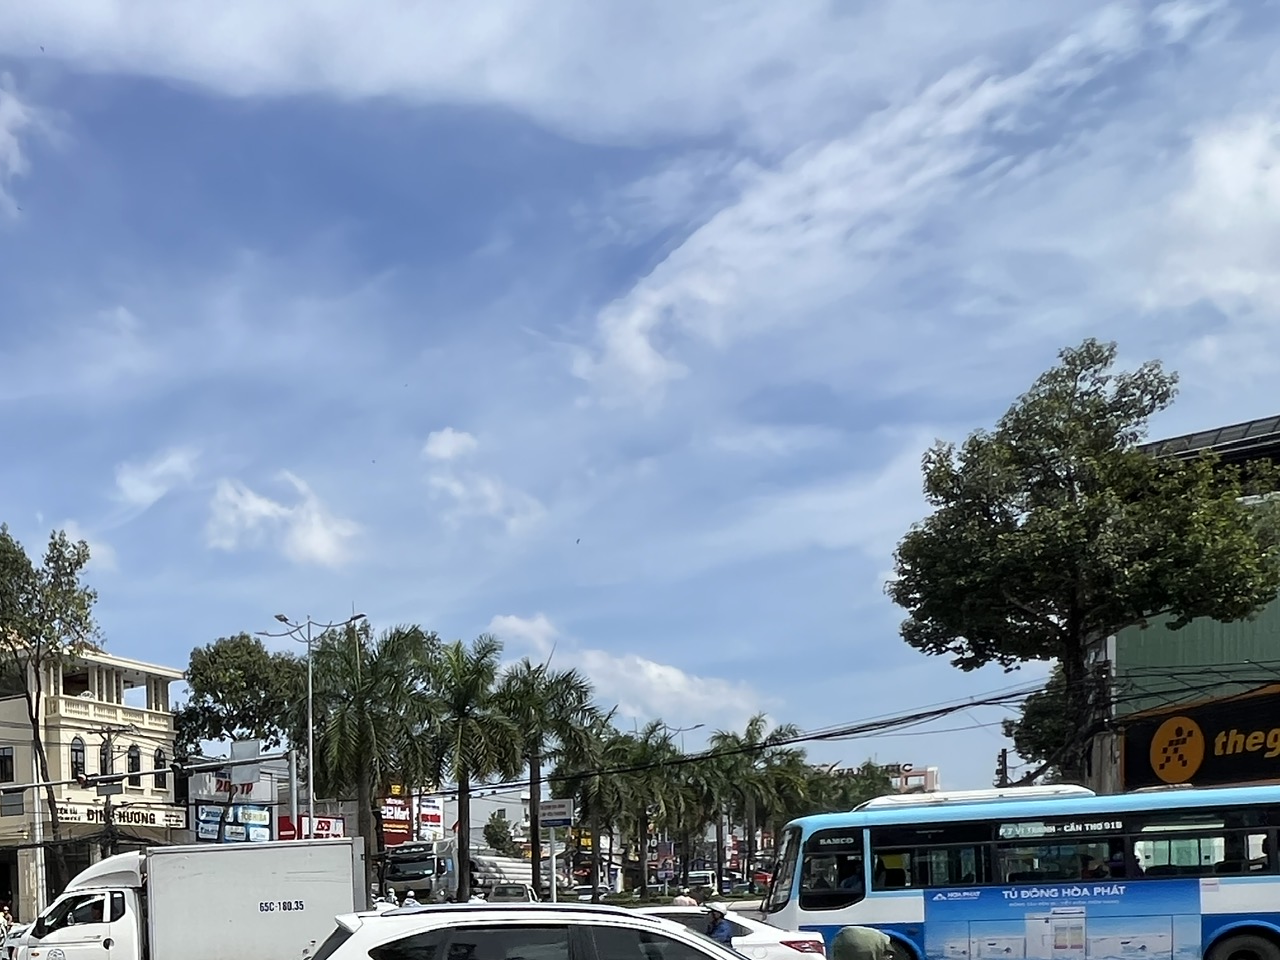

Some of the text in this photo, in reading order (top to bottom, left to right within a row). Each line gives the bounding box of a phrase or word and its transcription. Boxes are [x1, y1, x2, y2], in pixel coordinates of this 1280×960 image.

[1063, 822, 1082, 833] CẦN
[820, 837, 854, 845] SAMCO
[1002, 888, 1018, 899] TỦ
[1062, 886, 1090, 898] HÒA
[1093, 884, 1126, 896] PHÁT
[259, 900, 304, 912] 65C-180.35
